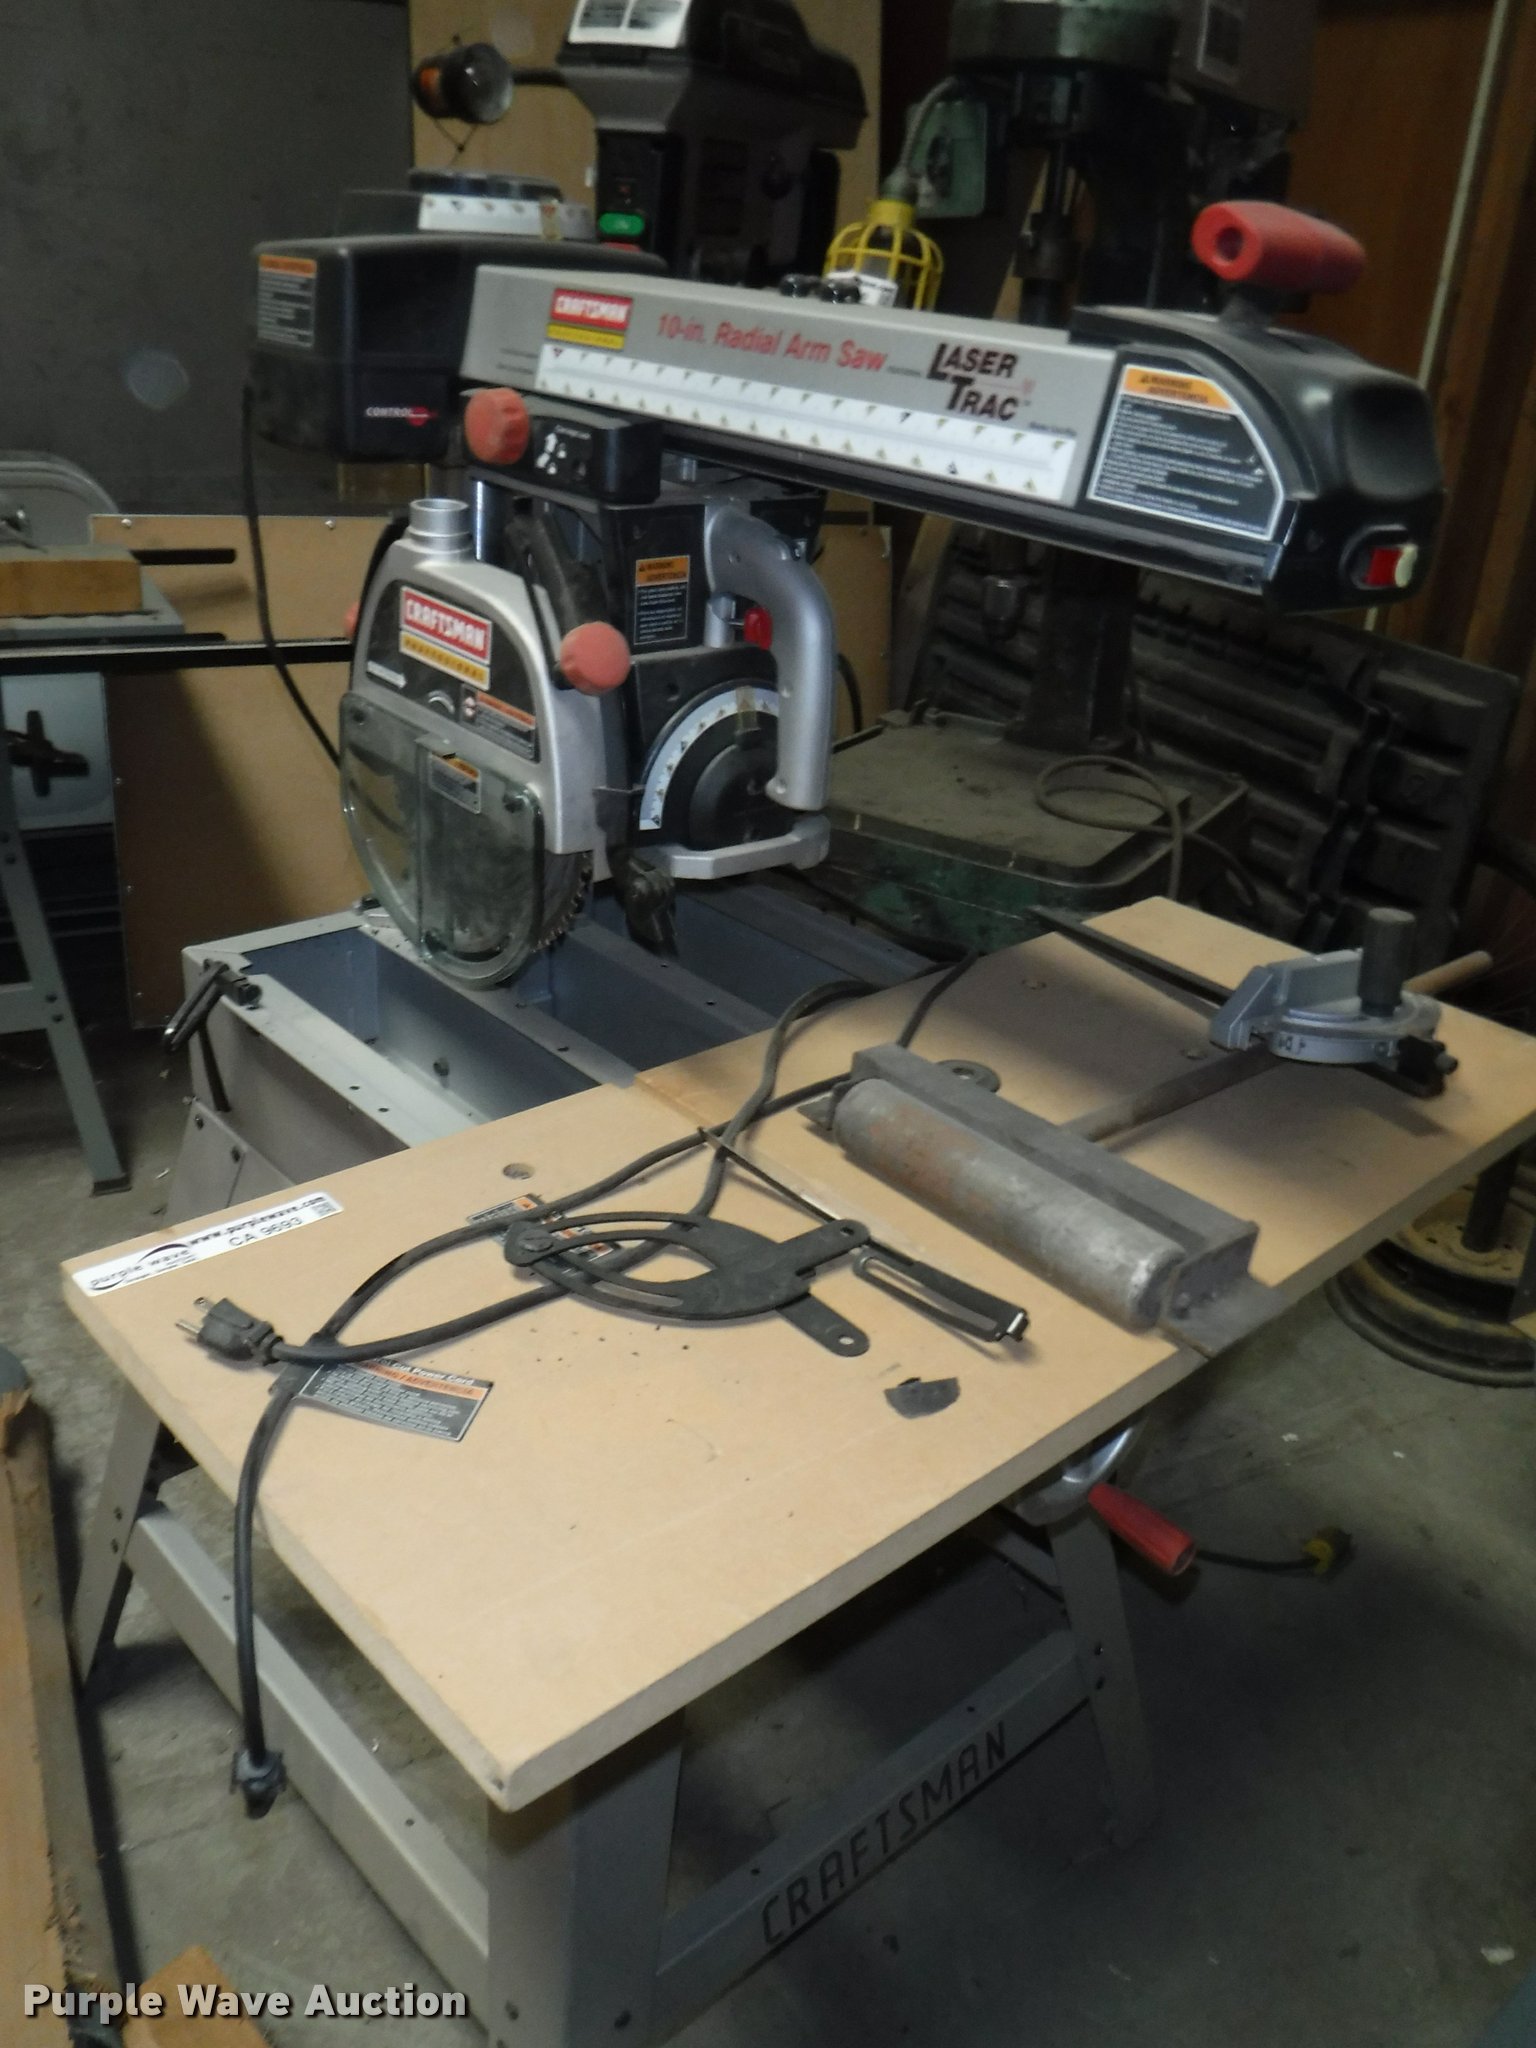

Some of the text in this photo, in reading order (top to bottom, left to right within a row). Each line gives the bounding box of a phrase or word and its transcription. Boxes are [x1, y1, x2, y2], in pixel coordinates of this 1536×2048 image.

[715, 320, 783, 355] Radial
[784, 332, 832, 362] Arm
[837, 338, 888, 372] Saw
[927, 343, 1018, 380] LASER
[947, 375, 1018, 421] TRAC
[406, 599, 485, 651] CRAFTSMAN
[762, 1721, 1006, 1945] CRAFTSMAN
